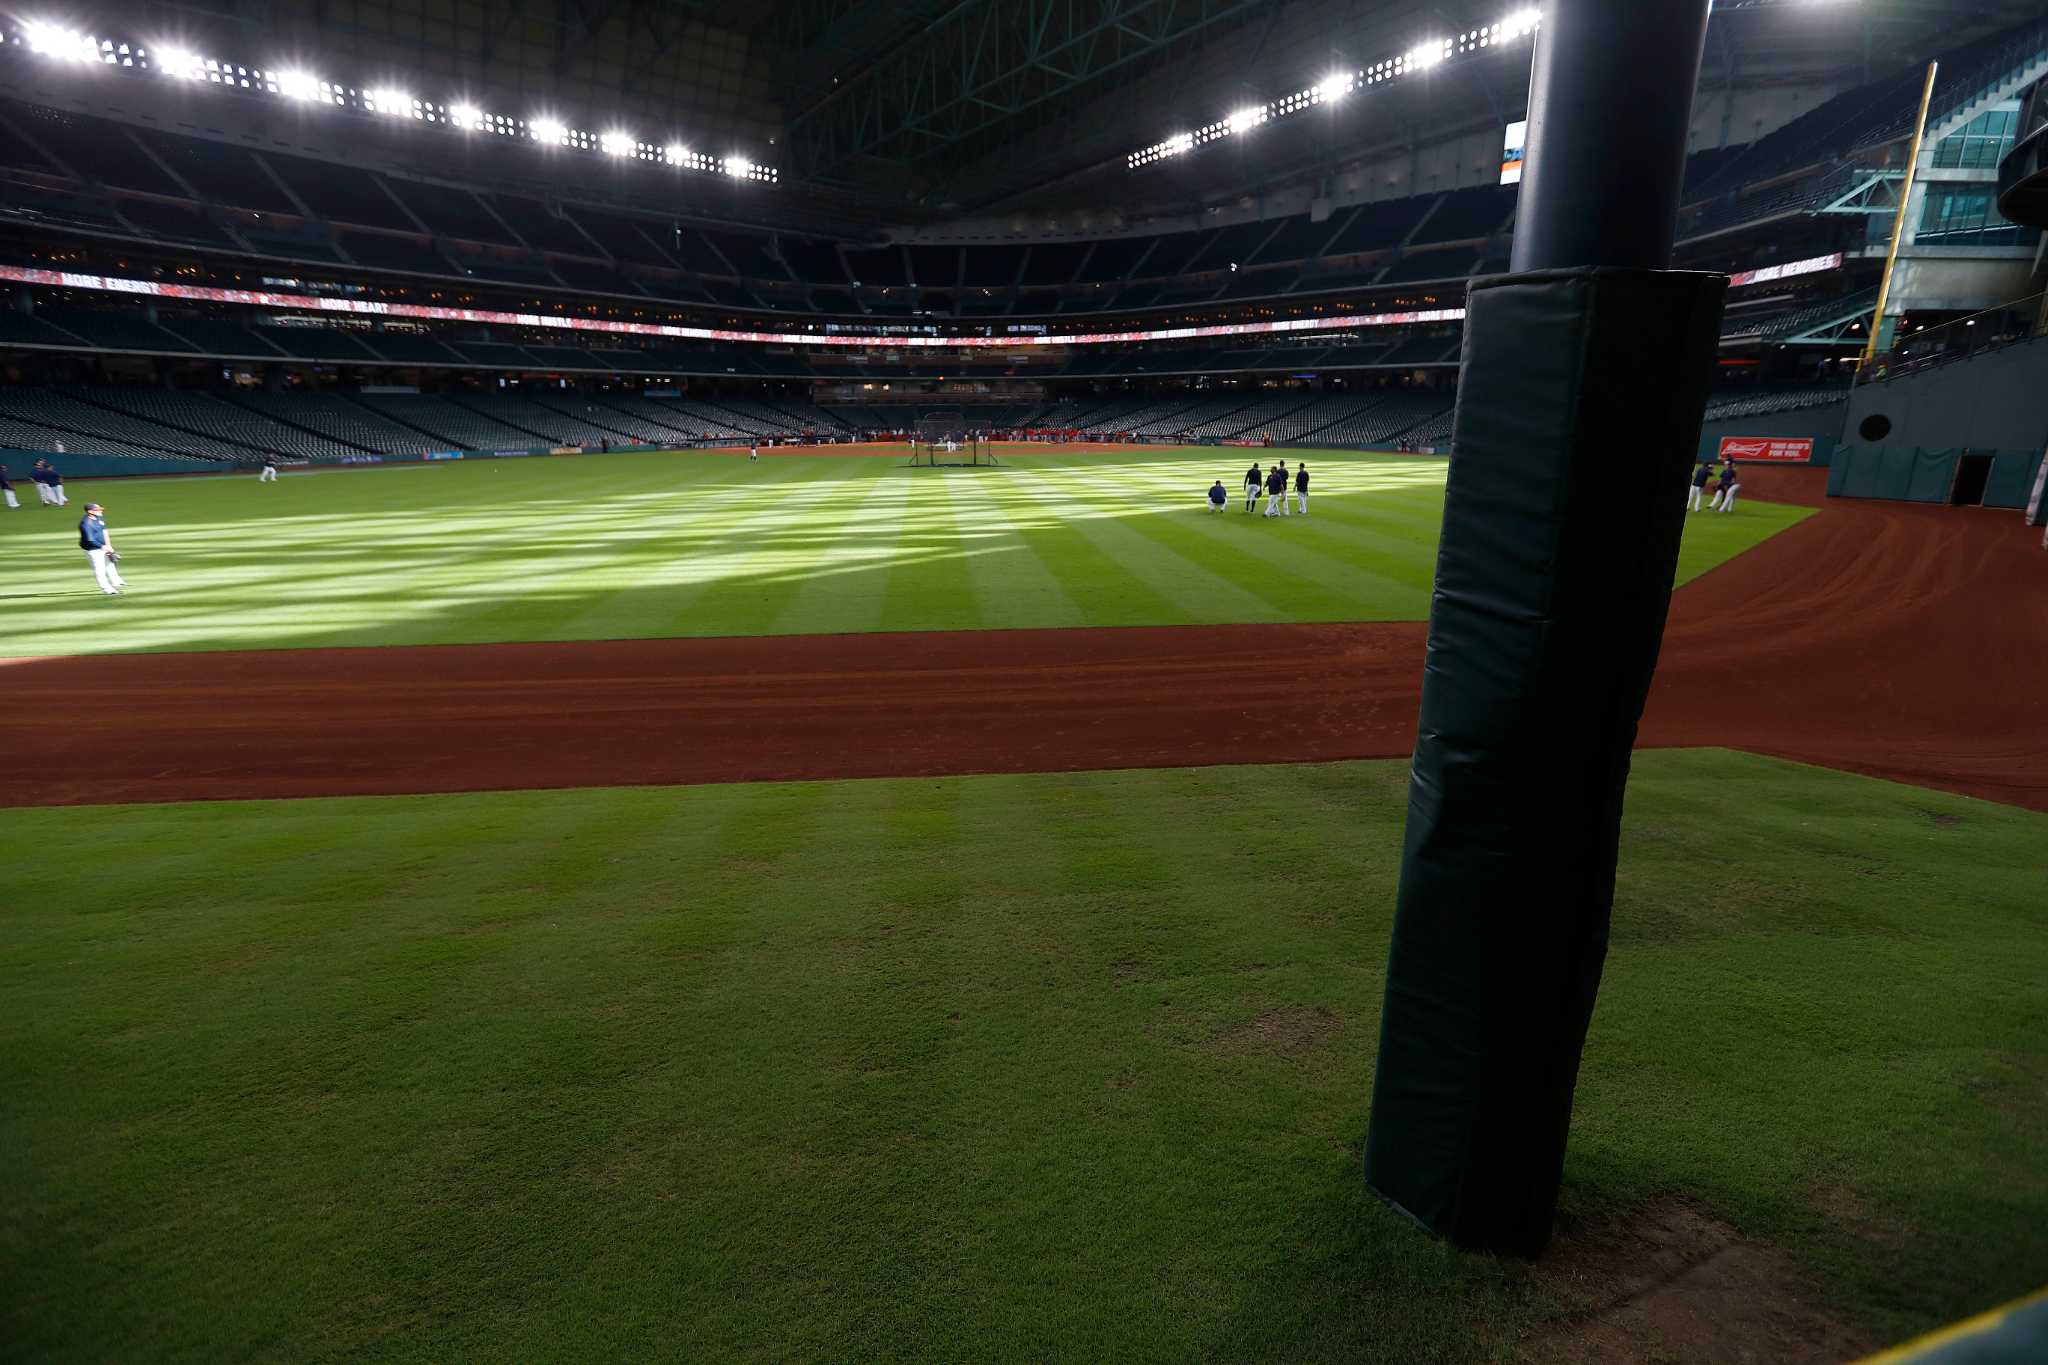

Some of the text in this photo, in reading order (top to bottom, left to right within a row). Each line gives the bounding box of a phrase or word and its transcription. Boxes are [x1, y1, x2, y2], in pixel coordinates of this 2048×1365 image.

[62, 273, 160, 294] MORE ENERGY
[320, 298, 388, 313] MORE HEART
[1443, 309, 1465, 319] HEA
